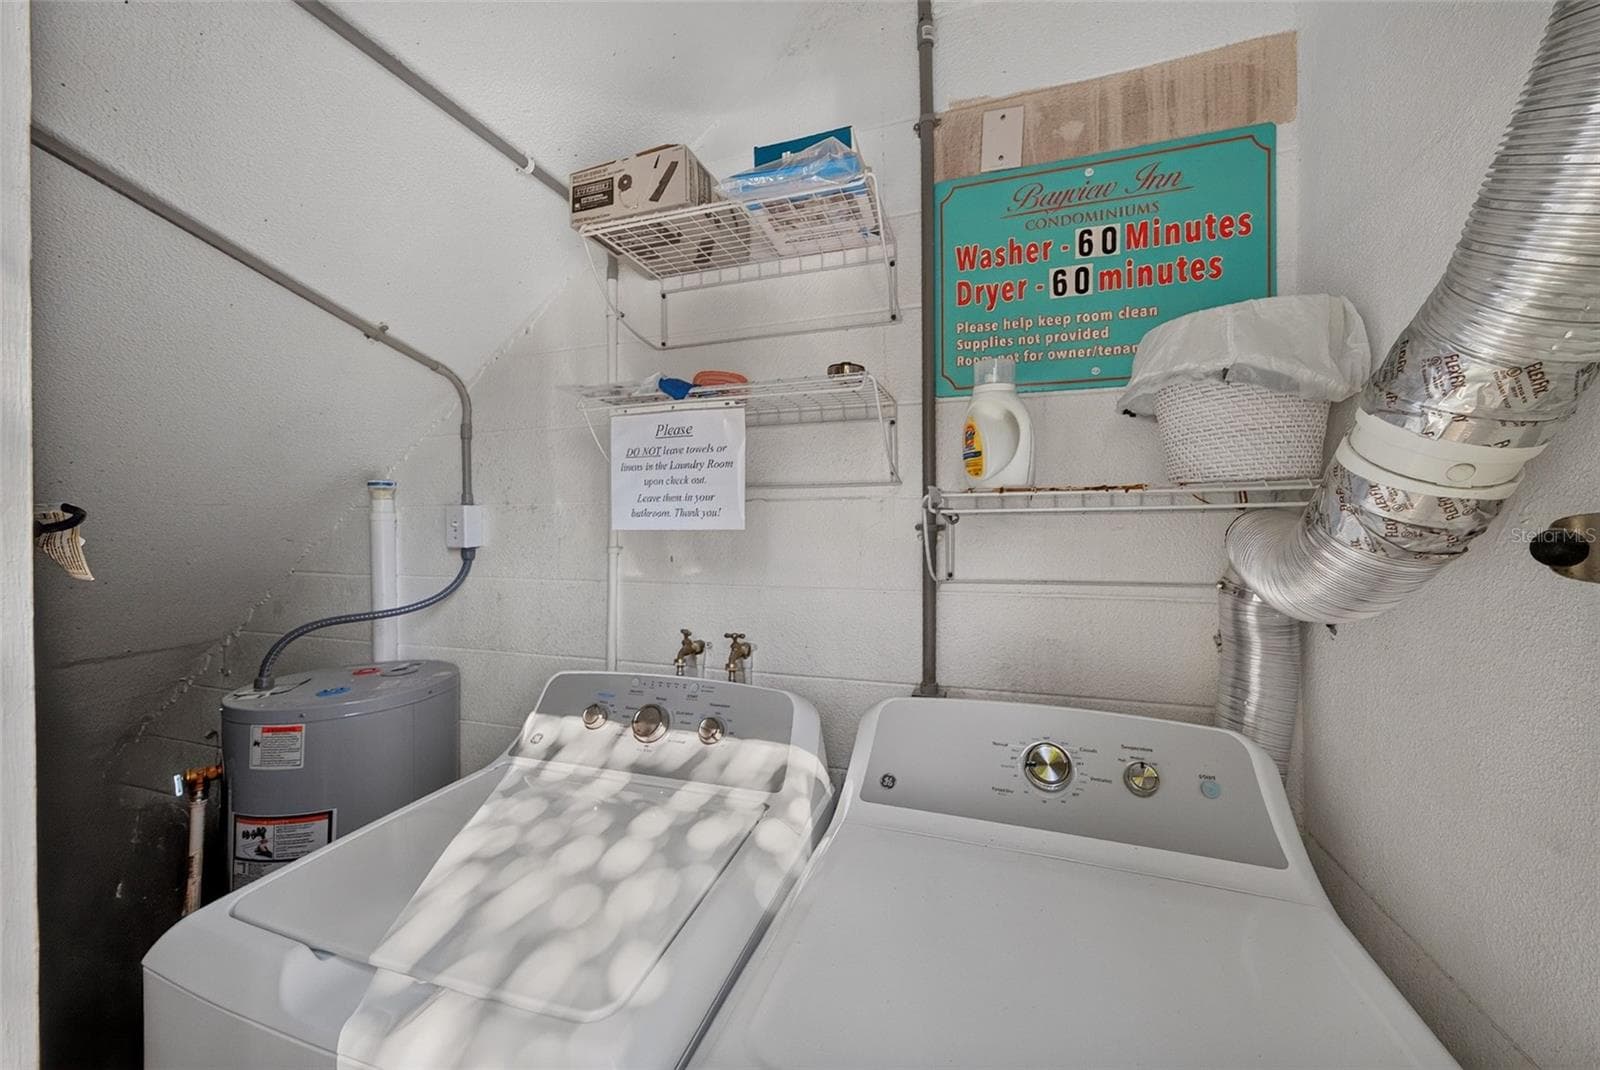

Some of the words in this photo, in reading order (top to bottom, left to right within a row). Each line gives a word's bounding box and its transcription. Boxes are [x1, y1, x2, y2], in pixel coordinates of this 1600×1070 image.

[1007, 180, 1118, 214] Bayview
[1125, 161, 1182, 194] Inn
[1025, 201, 1160, 231] CONDOMINIUMS
[955, 238, 1052, 272] Washer
[1078, 226, 1117, 257] 60
[1125, 212, 1252, 251] Minutes
[955, 278, 1028, 311] Dryer
[1052, 266, 1090, 297] 60
[1098, 256, 1224, 292] minutes
[956, 321, 998, 334] Please
[1003, 317, 1034, 331] help
[1038, 314, 1071, 328] keep
[1076, 310, 1113, 323] room
[1118, 306, 1158, 319] clean
[956, 335, 1014, 352] Supplies
[1018, 332, 1040, 345] not
[1045, 326, 1109, 346] provided
[1024, 349, 1043, 361] for
[1048, 343, 1142, 361] owner/tenan
[656, 424, 694, 439] Please
[626, 447, 640, 458] DO
[641, 446, 662, 457] NOT
[662, 445, 684, 455] leave
[686, 443, 714, 453] towels
[716, 445, 728, 453] or
[620, 462, 643, 472] linens
[645, 462, 654, 471] in
[655, 460, 668, 470] the
[669, 459, 705, 473] Laundry
[707, 459, 734, 469] Room
[644, 478, 664, 488] upon
[665, 475, 689, 485] check
[691, 476, 707, 485] out.
[637, 493, 661, 503] Leave
[662, 493, 682, 502] them
[684, 493, 693, 502] in
[694, 493, 716, 504] your
[631, 508, 672, 518] bathroom.
[674, 507, 700, 518] Thank
[700, 507, 722, 520] you!
